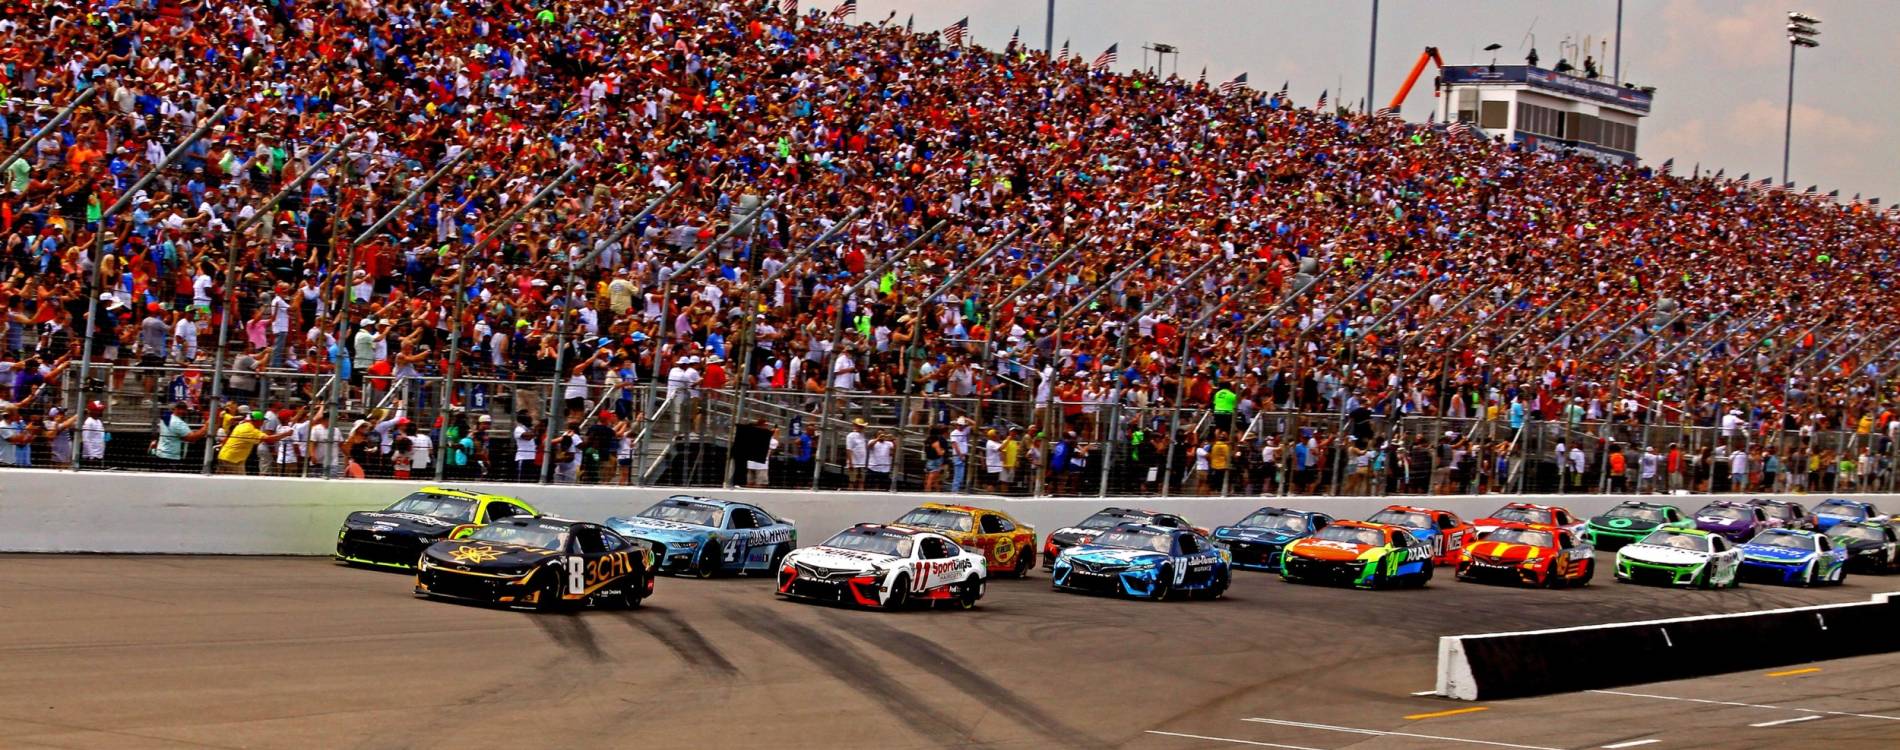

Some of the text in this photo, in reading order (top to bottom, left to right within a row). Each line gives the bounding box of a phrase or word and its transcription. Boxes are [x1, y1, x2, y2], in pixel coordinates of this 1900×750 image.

[723, 533, 740, 562] 4
[568, 556, 584, 594] 8
[912, 561, 931, 592] 11
[1172, 556, 1188, 585] 19
